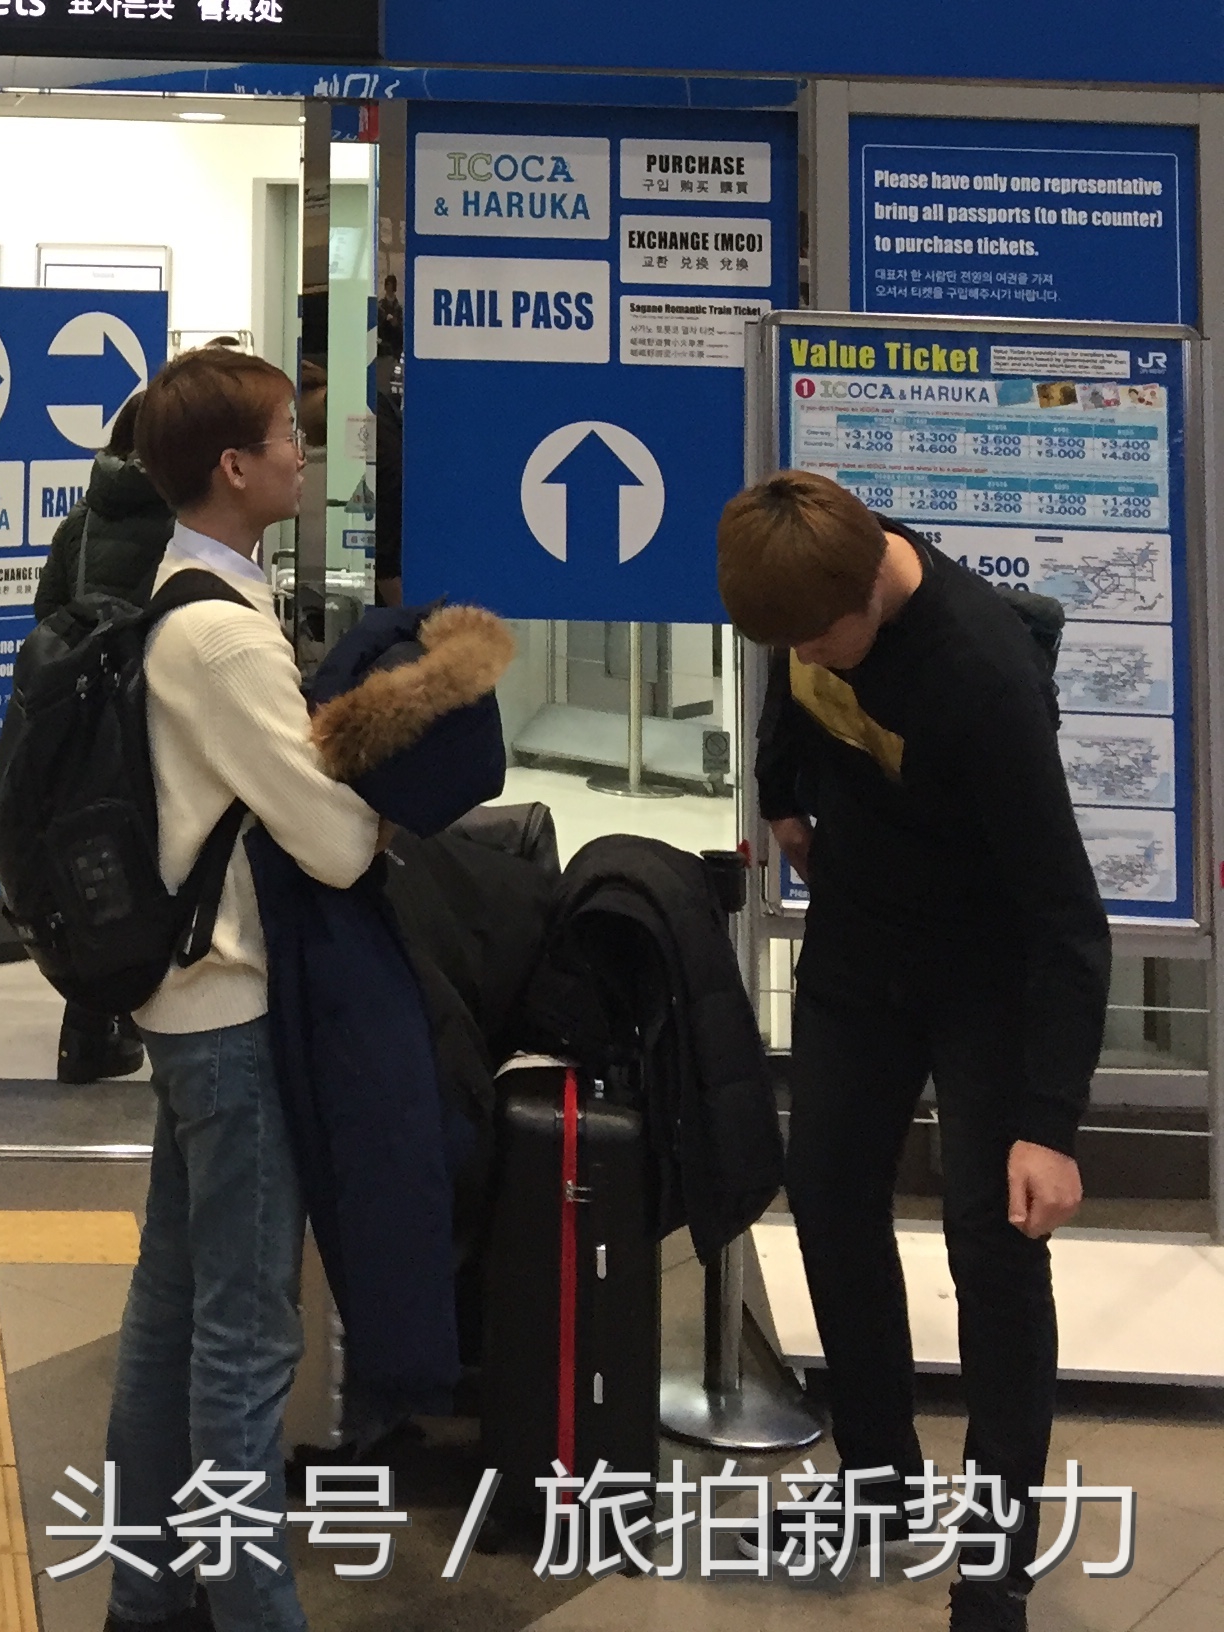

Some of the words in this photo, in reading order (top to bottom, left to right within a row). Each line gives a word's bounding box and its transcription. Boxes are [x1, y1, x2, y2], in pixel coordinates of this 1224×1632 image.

[446, 151, 575, 183] ICOCA
[646, 154, 745, 176] PURCHASE
[642, 178, 669, 193] 구입
[874, 170, 928, 189] Please
[931, 172, 970, 191] have
[973, 173, 1008, 193] only
[1011, 176, 1041, 192] one
[1044, 177, 1163, 196] representative
[434, 196, 449, 217] &
[462, 191, 591, 220] HARUKA
[875, 202, 918, 223] bring
[922, 203, 943, 221] all
[948, 205, 1030, 225] passports
[1034, 206, 1057, 225] (to
[1061, 208, 1088, 226] the
[1092, 209, 1163, 228] counter)
[628, 230, 709, 251] EXCHANGE
[714, 232, 763, 253] (MCO)
[874, 235, 891, 252] to
[895, 236, 973, 255] purchase
[977, 237, 1039, 256] tickets.
[642, 255, 669, 269] 교환
[433, 288, 502, 328] RAIL
[512, 290, 594, 331] PASS
[665, 304, 707, 315] Romantic
[708, 305, 732, 315] Train
[733, 306, 762, 316] Ticket
[790, 338, 876, 369] Value
[884, 342, 979, 373] Ticket
[1137, 351, 1168, 369] JR
[819, 380, 895, 400] ICOCA
[910, 384, 991, 404] HARUKA
